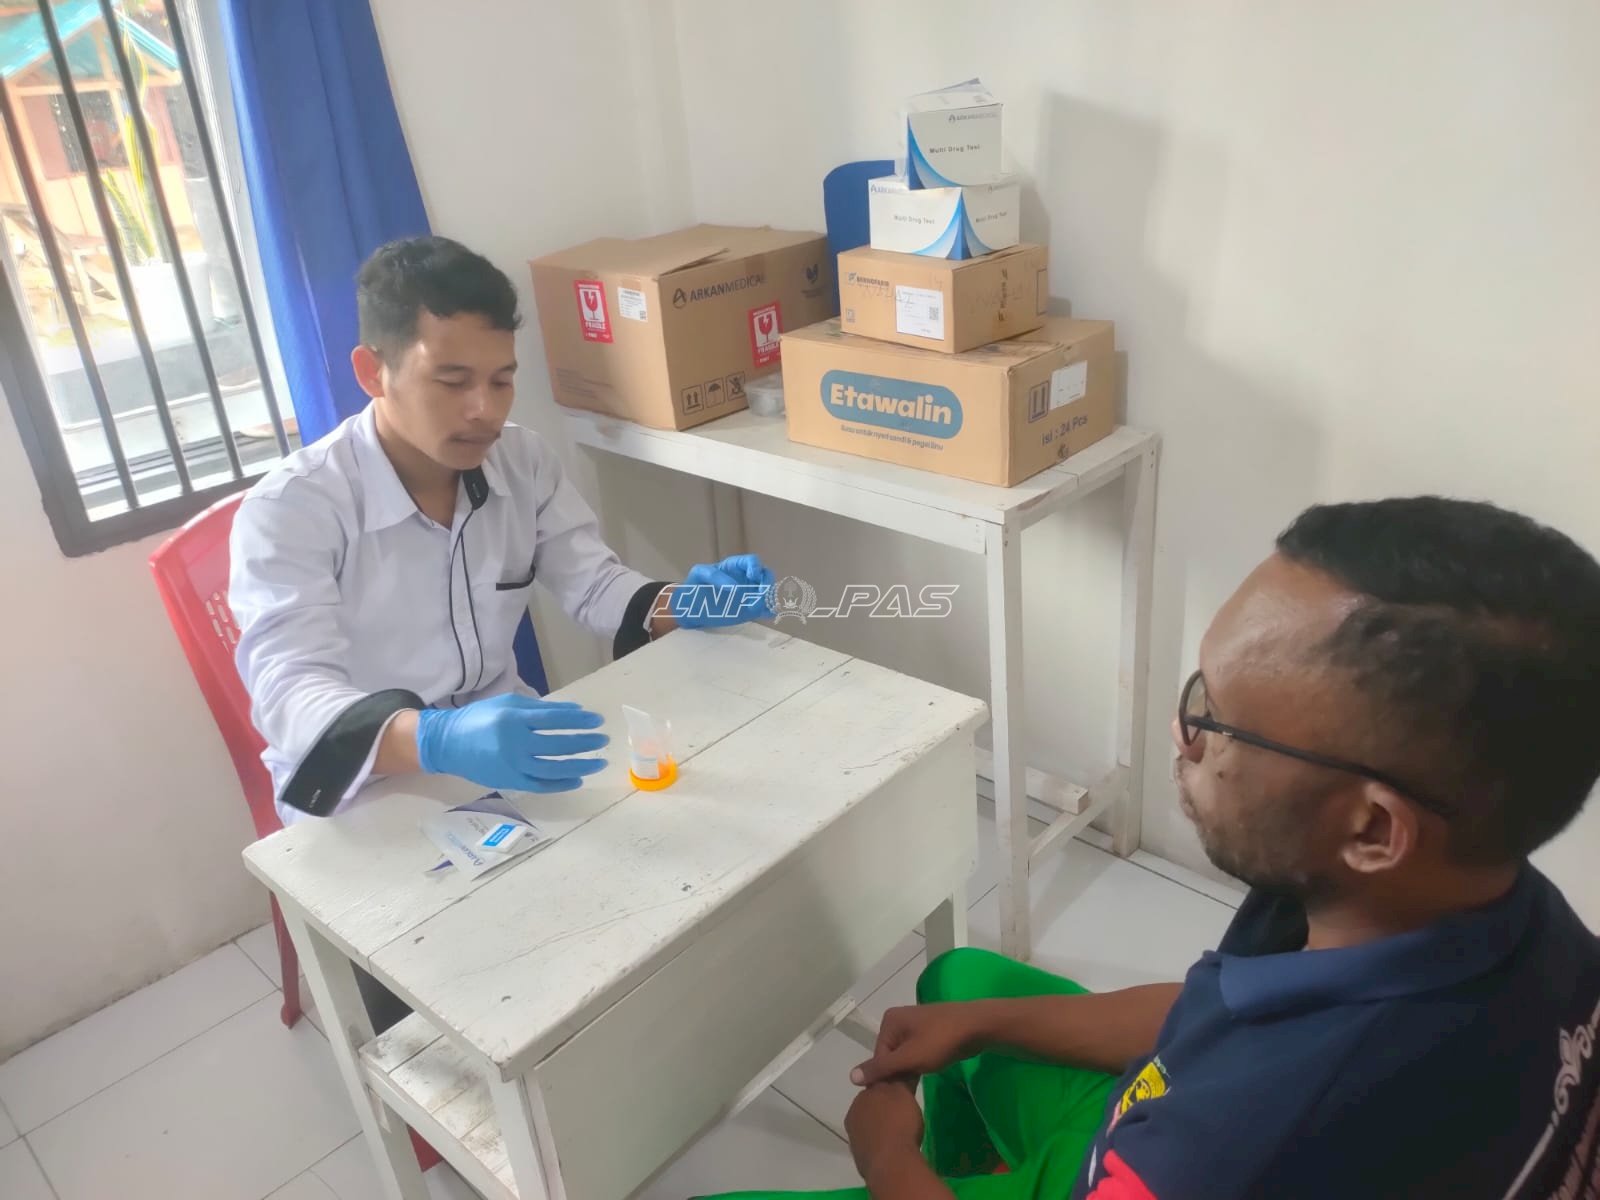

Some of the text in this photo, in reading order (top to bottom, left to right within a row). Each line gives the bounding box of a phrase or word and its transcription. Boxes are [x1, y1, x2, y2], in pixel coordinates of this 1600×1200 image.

[689, 272, 766, 302] ARKANMEDICAL
[830, 382, 952, 425] Etawalin
[1060, 420, 1070, 436] 24
[1072, 415, 1088, 430] Pcs
